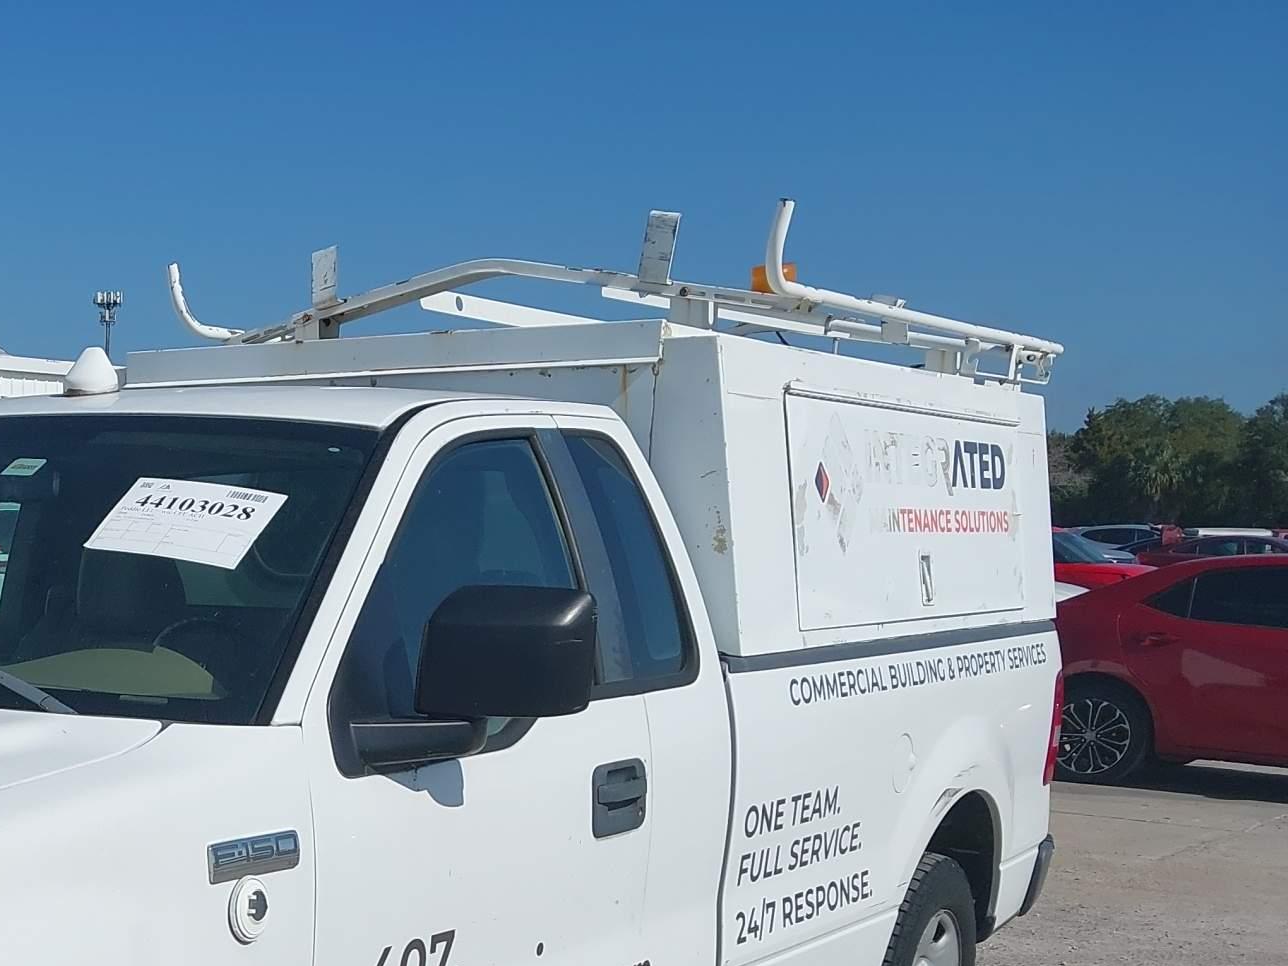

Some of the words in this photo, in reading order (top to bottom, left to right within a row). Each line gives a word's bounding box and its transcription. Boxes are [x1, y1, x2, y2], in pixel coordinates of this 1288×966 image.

[135, 494, 255, 520] 44103028
[955, 510, 1009, 532] SOLUTIONS
[789, 667, 887, 706] COMMERCIAL
[888, 657, 946, 690] BUILDING
[948, 658, 955, 680] &
[956, 649, 1006, 679] PROPERTY
[1008, 643, 1047, 670] SERVICES
[744, 799, 786, 838] ONE
[791, 785, 841, 826] TEAM.
[737, 845, 783, 887] FULL
[787, 822, 862, 871] SERVICE.
[735, 897, 776, 944] 24/7
[782, 870, 873, 928] RESPONSE.
